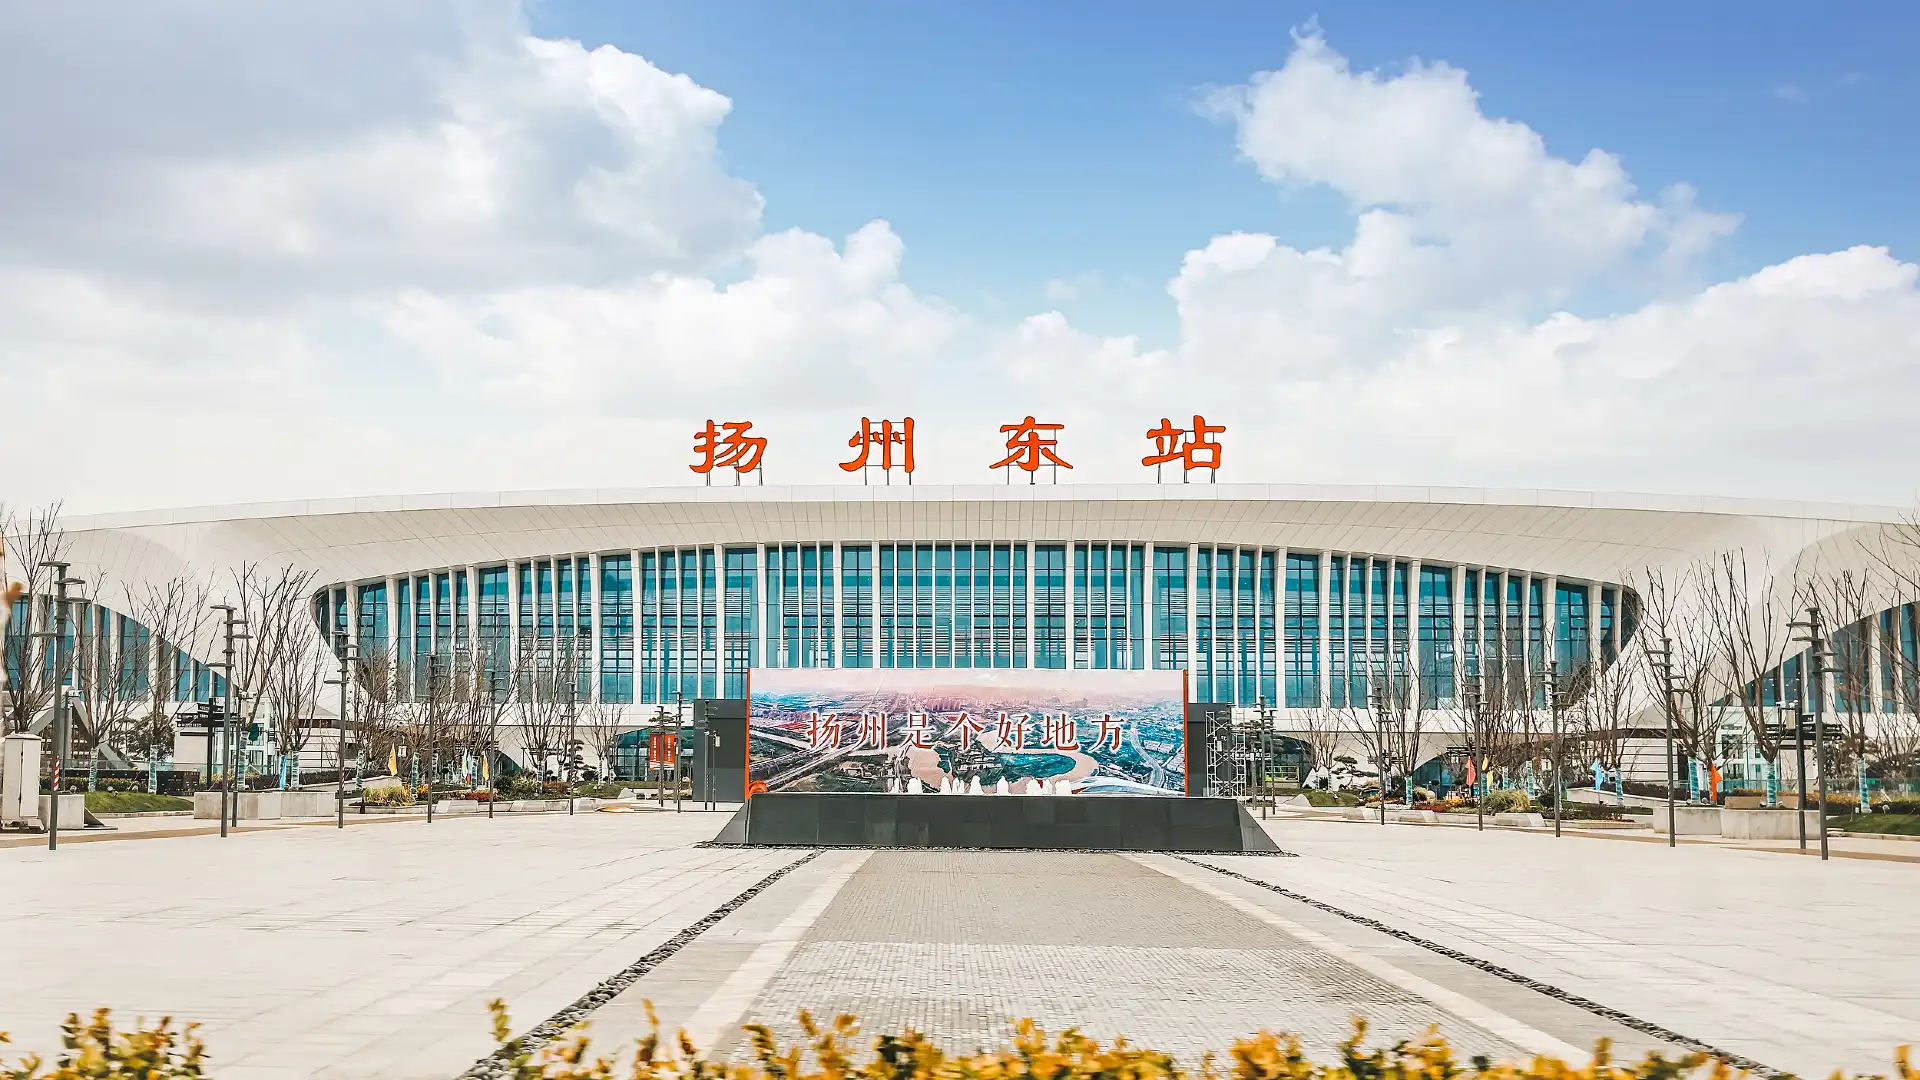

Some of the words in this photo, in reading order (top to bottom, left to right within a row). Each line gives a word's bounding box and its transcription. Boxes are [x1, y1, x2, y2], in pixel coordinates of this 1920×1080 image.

[689, 415, 1226, 473] 扬州东站
[806, 711, 1125, 752] 扬州是个好地方
